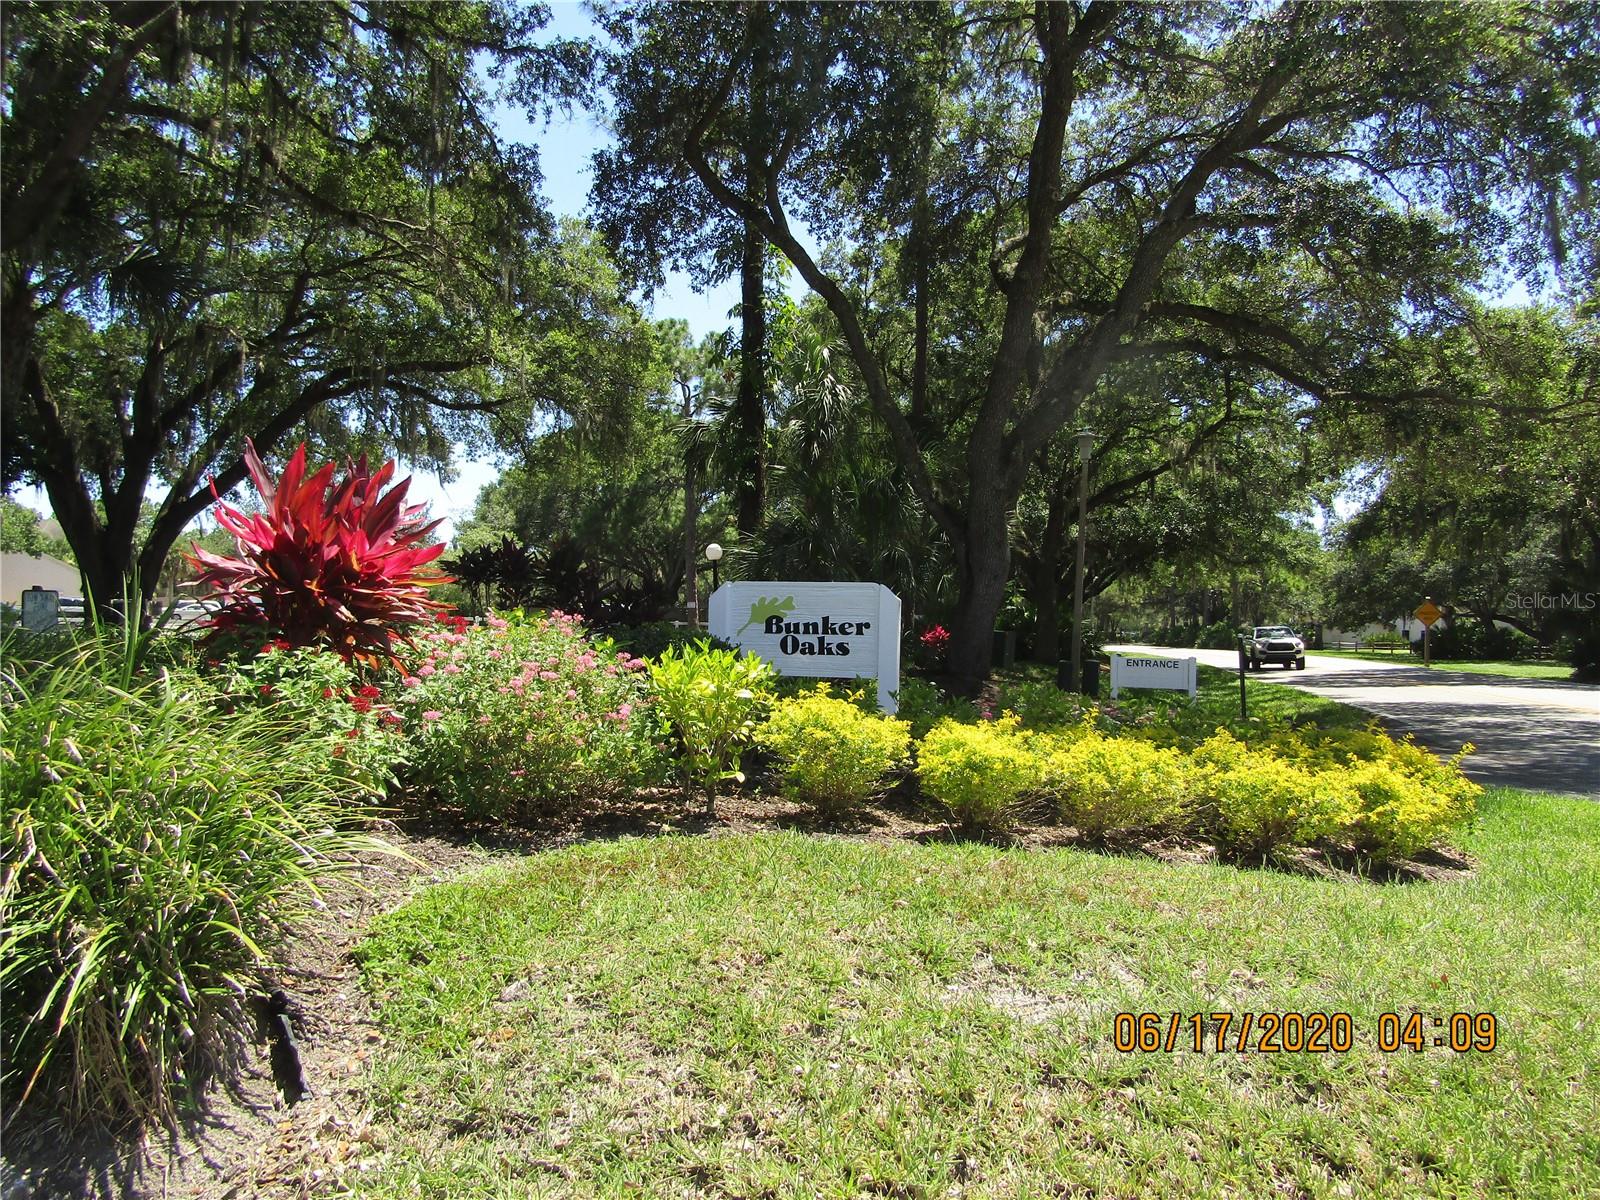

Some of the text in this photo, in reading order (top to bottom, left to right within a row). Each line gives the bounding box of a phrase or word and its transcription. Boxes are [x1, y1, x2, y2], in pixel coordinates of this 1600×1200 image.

[764, 615, 871, 636] Bunker
[779, 634, 850, 656] Oaks
[1126, 658, 1179, 669] ENTRANCE
